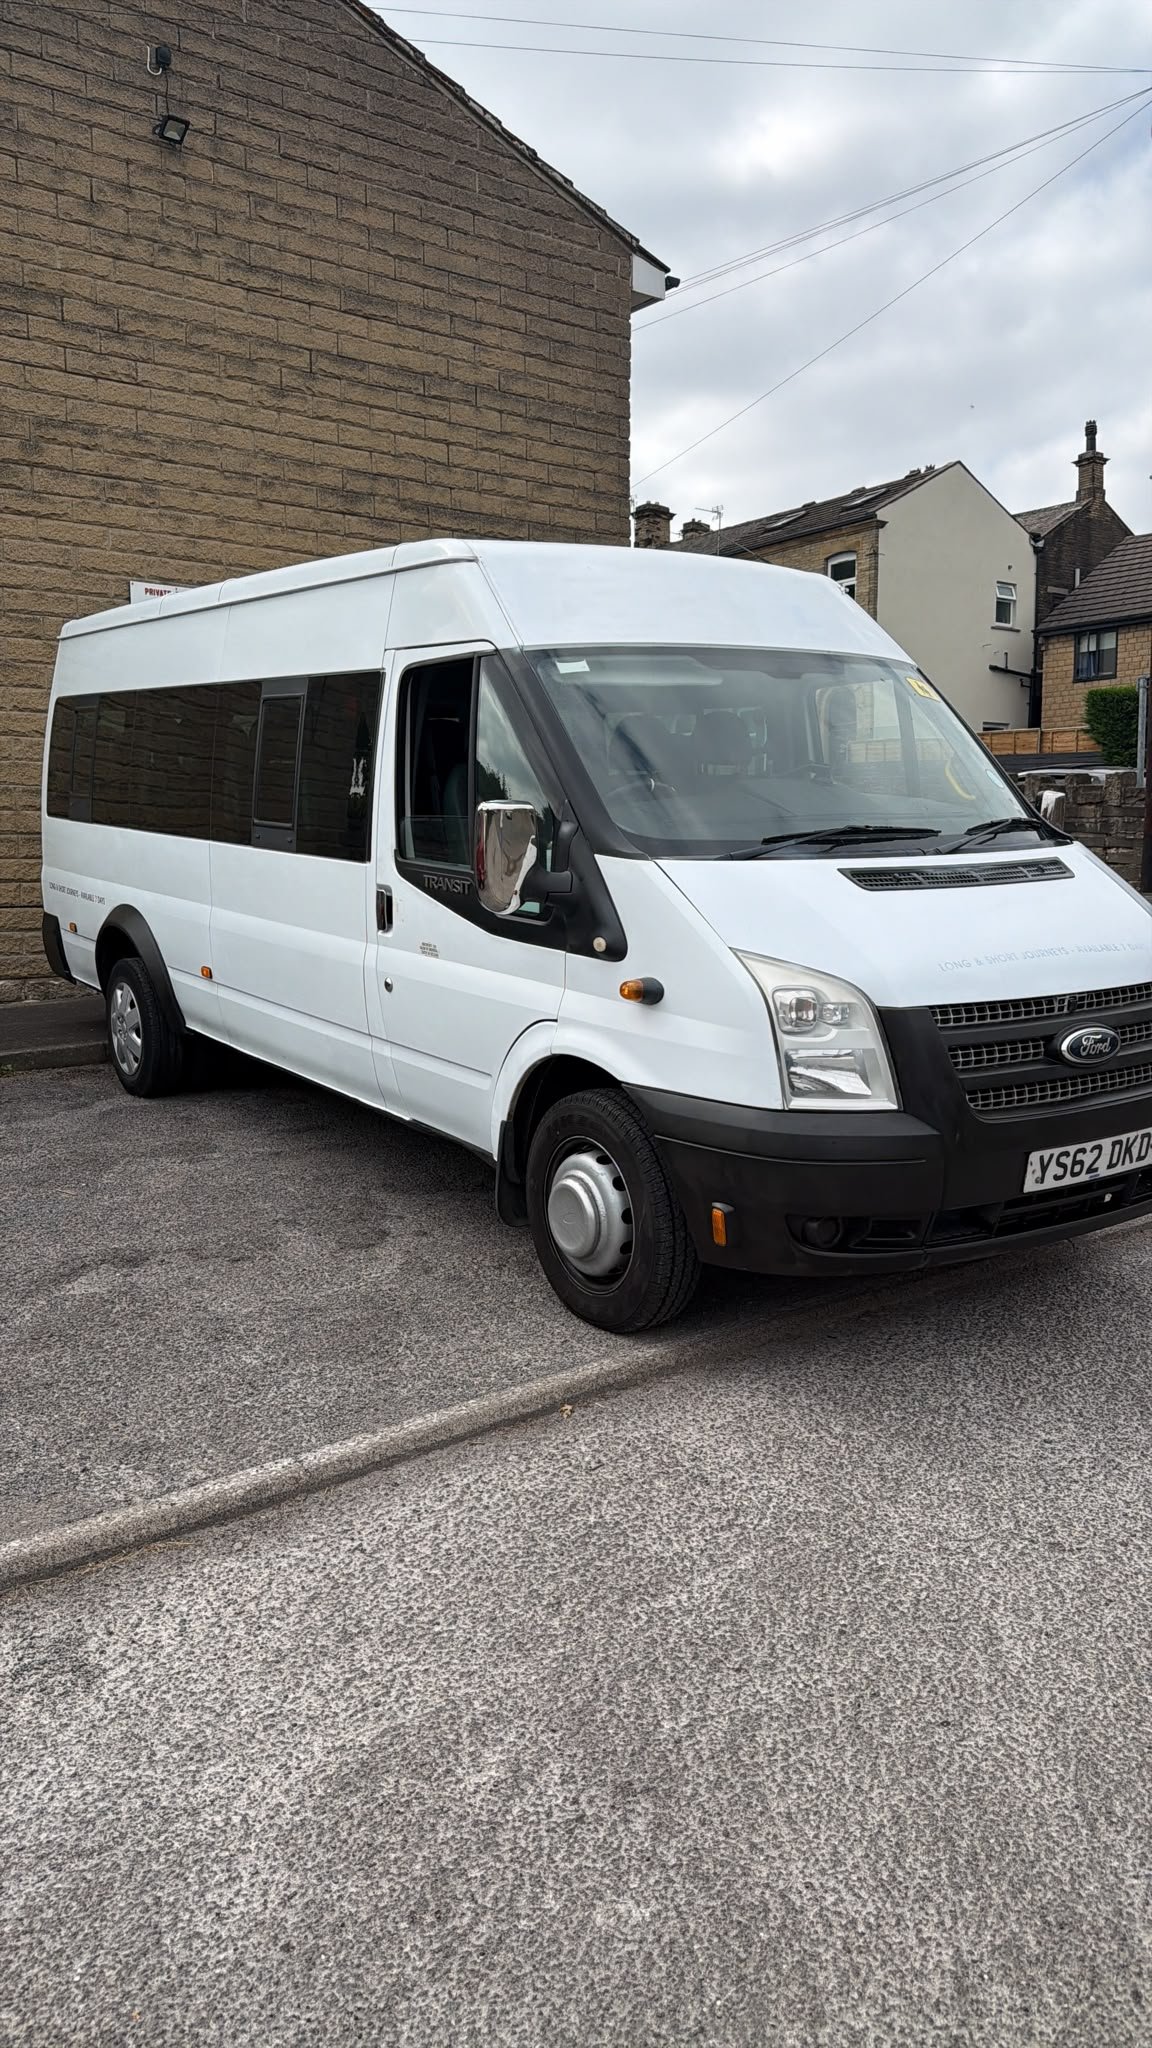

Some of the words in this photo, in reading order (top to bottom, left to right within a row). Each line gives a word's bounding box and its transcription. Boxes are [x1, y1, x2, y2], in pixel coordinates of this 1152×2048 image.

[423, 874, 470, 895] TRANSIT
[938, 959, 972, 972] LONG
[974, 958, 984, 967] &
[985, 952, 1019, 965] SHORT
[1022, 946, 1070, 961] JOURNEYS
[1077, 943, 1120, 954] AVAILABLE
[1080, 1034, 1111, 1056] Ford
[1038, 1143, 1103, 1184] YS62
[1106, 1132, 1151, 1170] DKD
